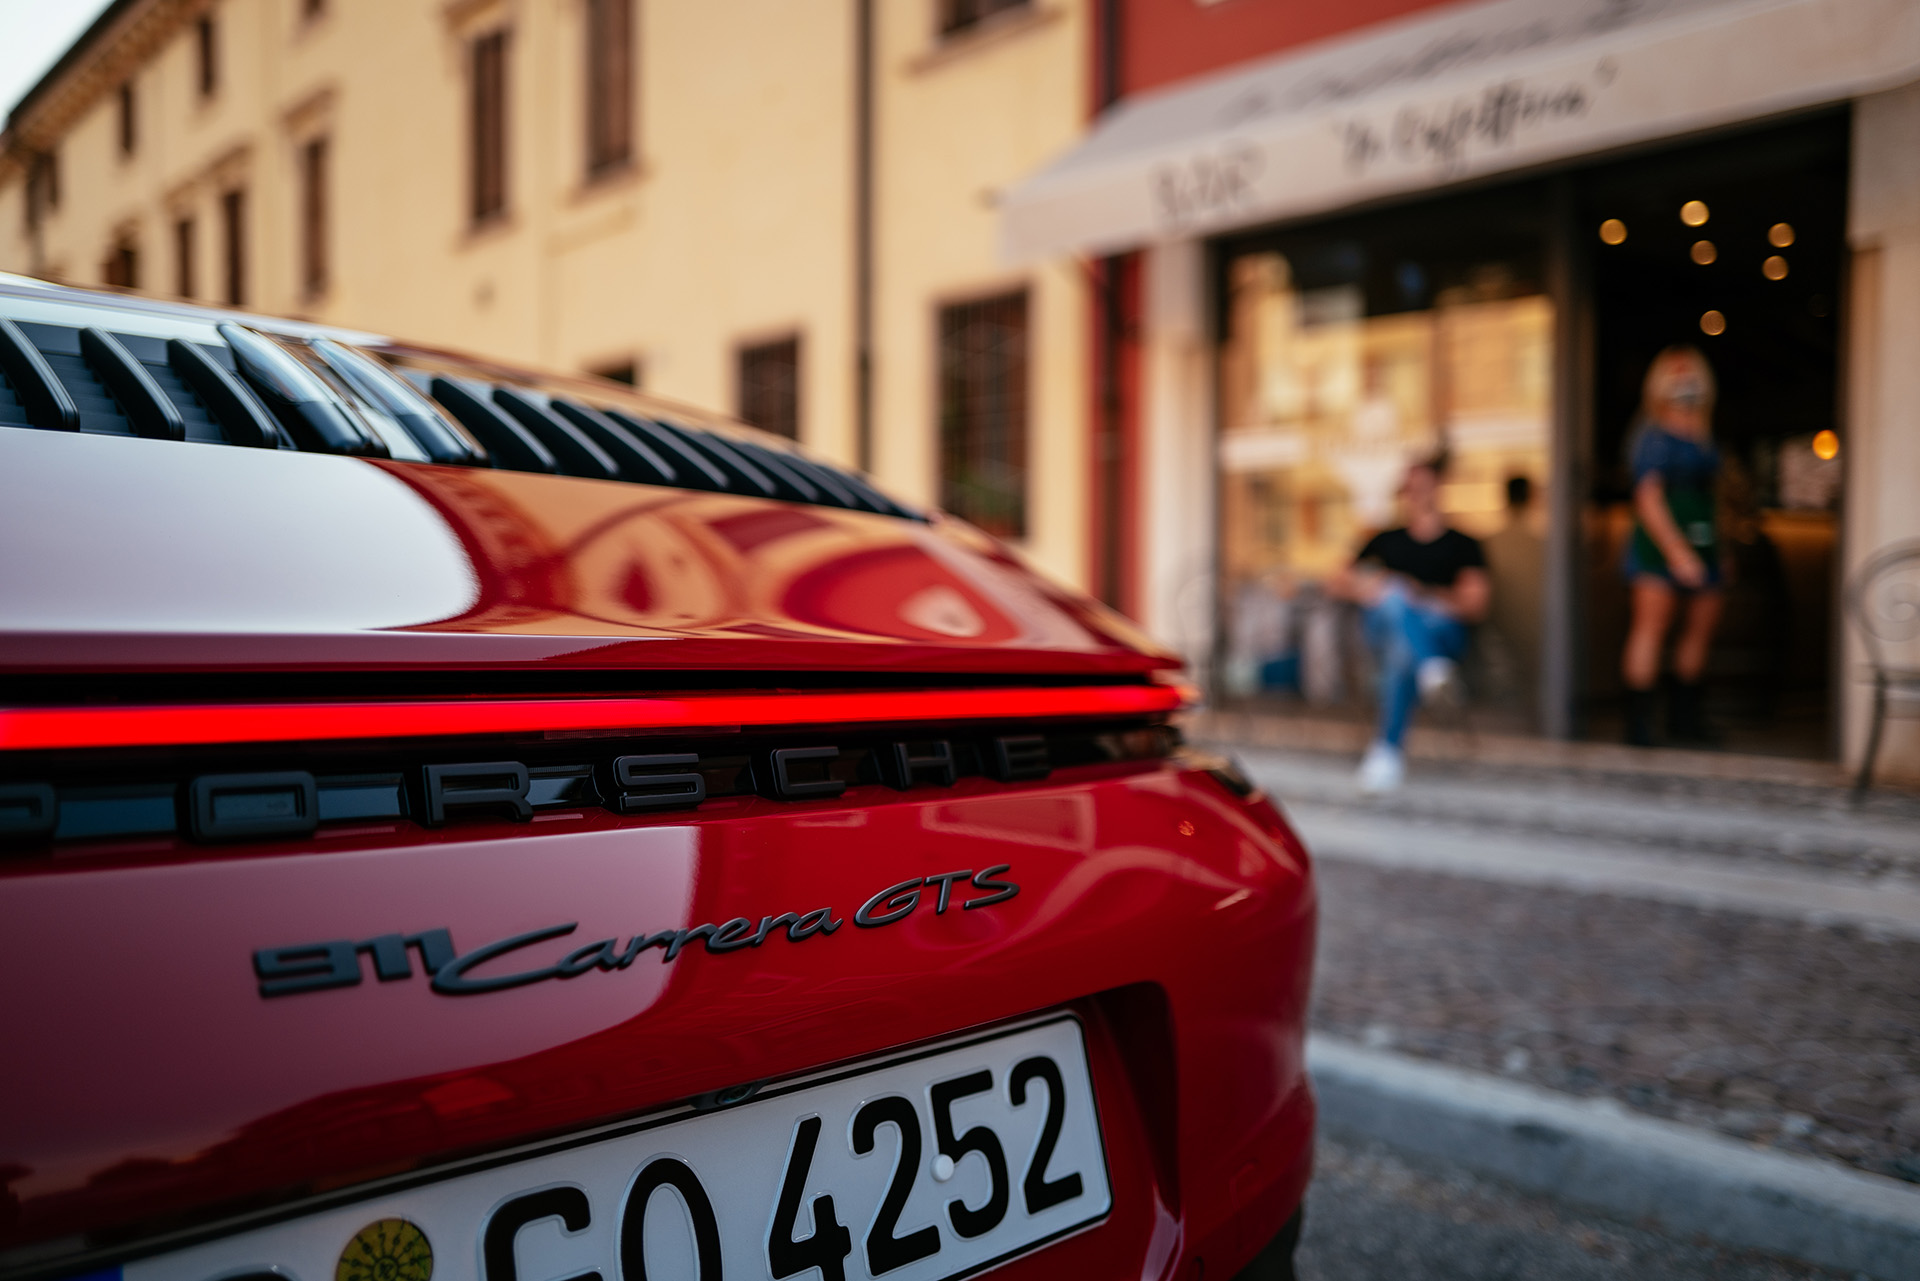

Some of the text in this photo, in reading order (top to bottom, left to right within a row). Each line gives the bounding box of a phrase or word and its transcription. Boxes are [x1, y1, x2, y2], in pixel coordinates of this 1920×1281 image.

[253, 863, 1021, 998] 911 Carrera GTS
[767, 1055, 1084, 1281] 4252
